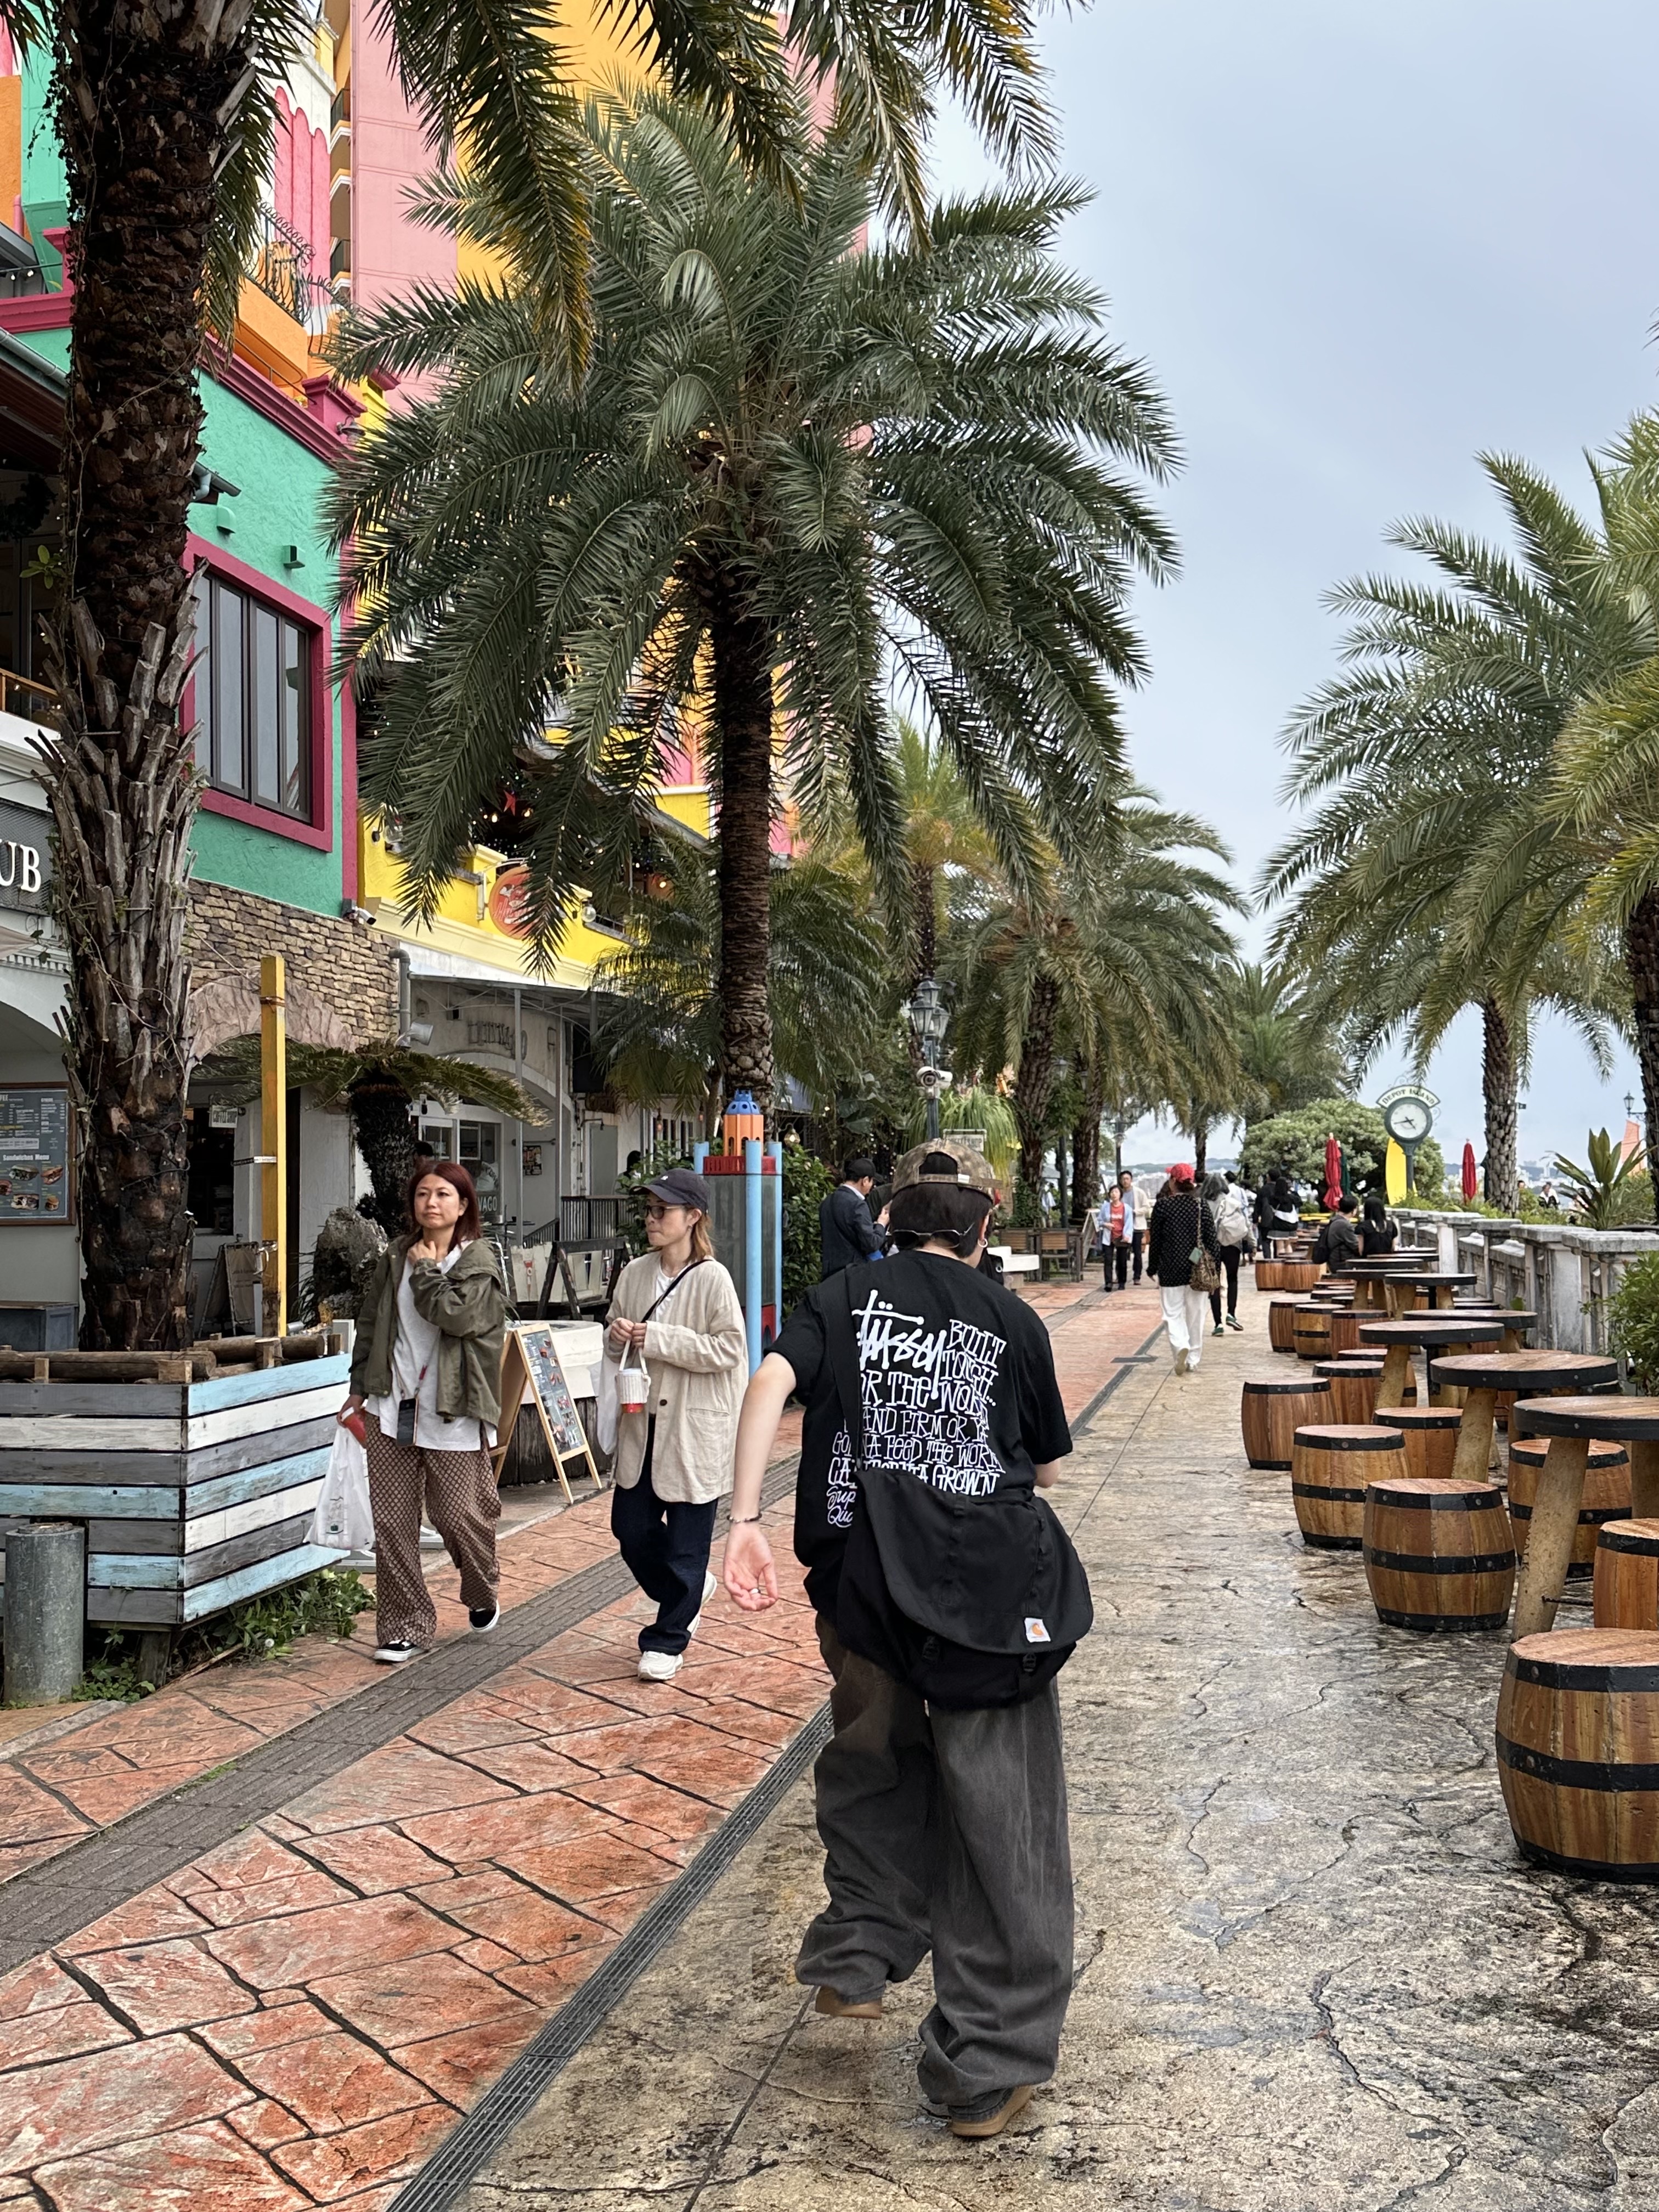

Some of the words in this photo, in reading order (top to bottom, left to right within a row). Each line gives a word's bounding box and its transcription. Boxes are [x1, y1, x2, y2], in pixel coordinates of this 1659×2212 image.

[1383, 1089, 1406, 1104] DEPOT
[946, 1319, 1007, 1368] BUILT
[899, 1410, 949, 1442] FIRM
[946, 1414, 971, 1444] OR
[932, 1464, 1000, 1497] GROWN
